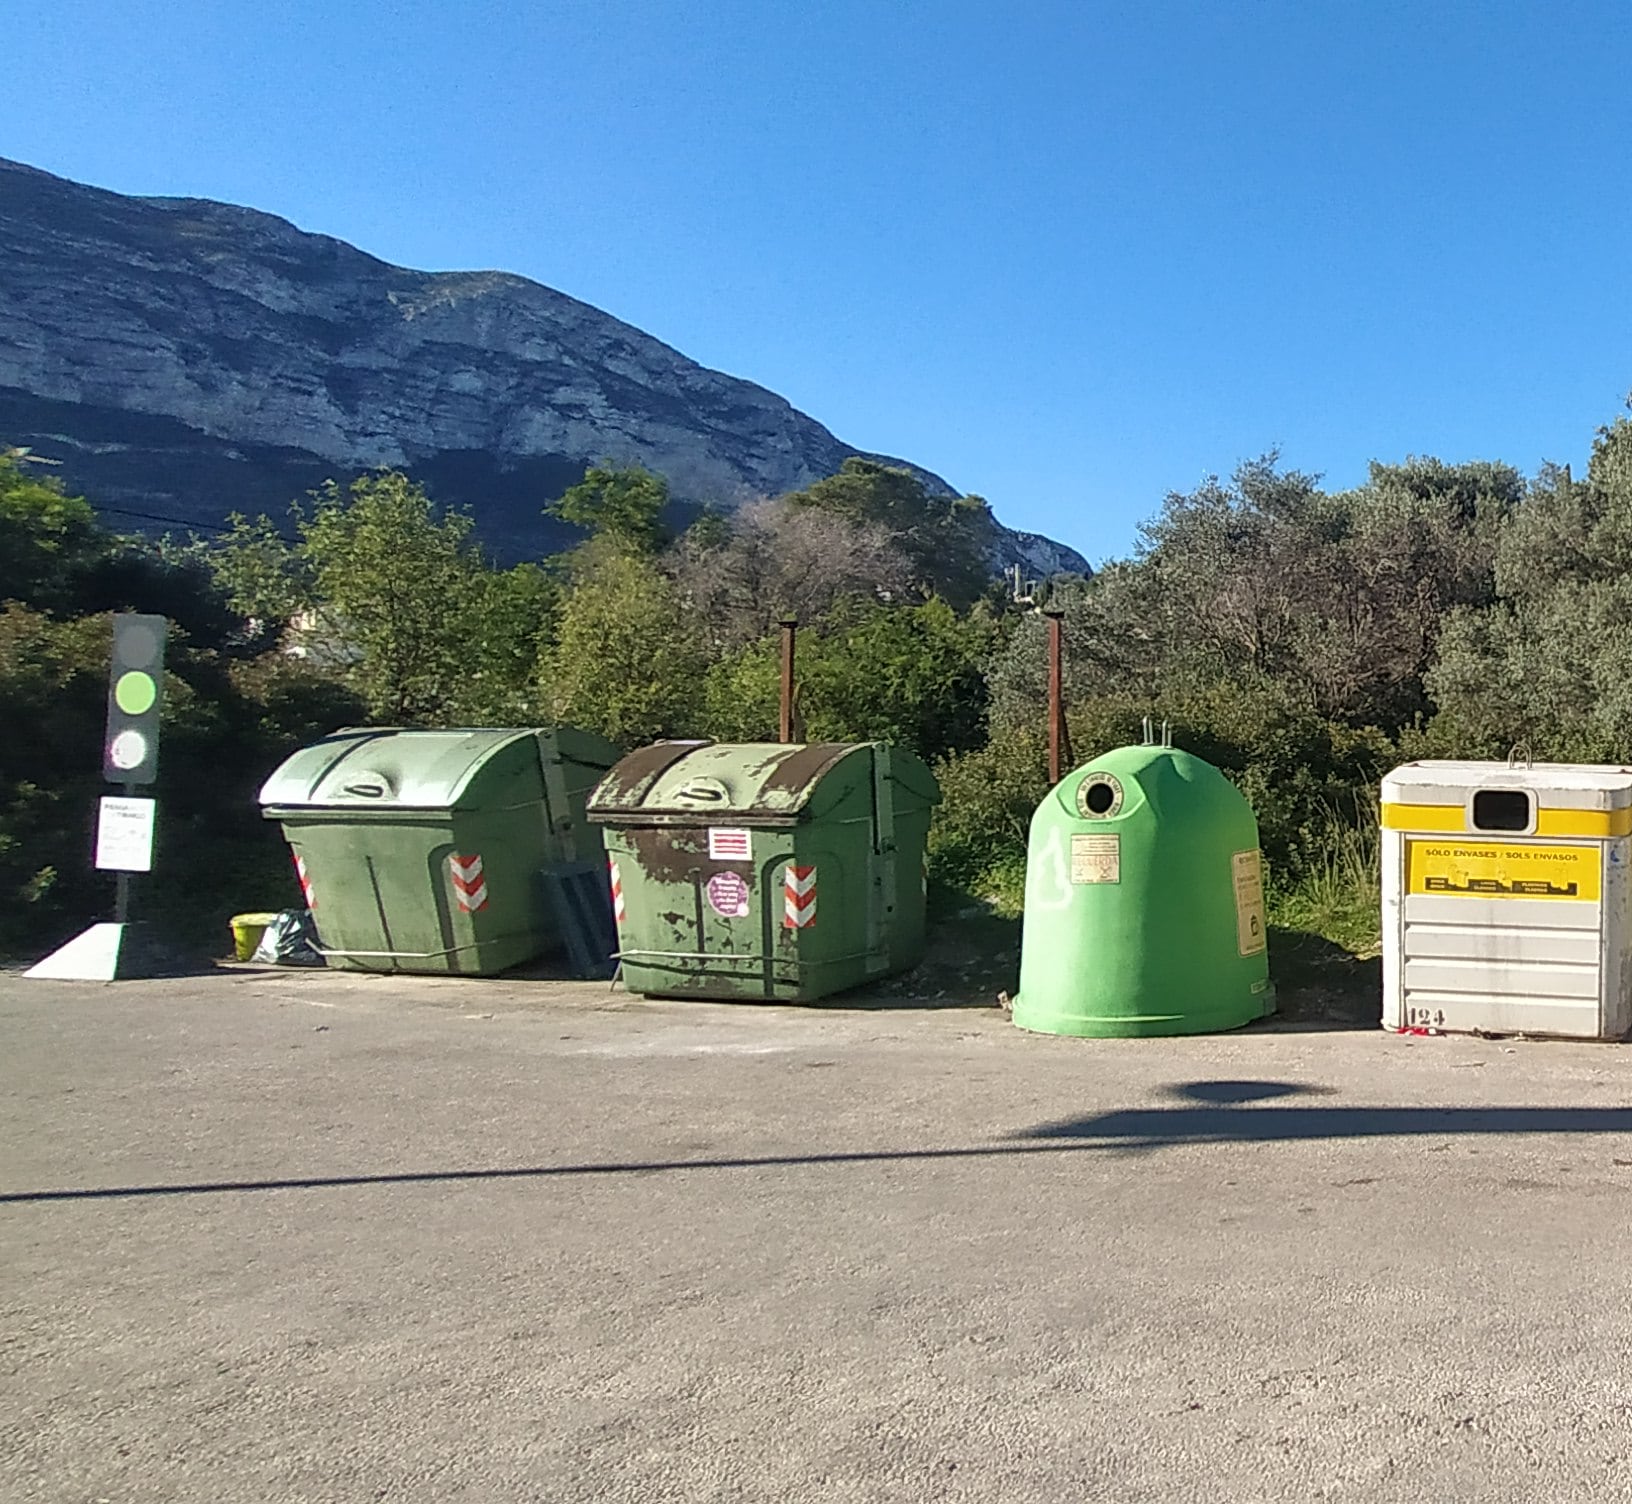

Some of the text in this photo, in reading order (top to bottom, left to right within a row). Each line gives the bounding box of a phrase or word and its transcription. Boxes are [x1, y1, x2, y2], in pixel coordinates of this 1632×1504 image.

[1453, 850, 1497, 858] ENVASES
[1505, 852, 1531, 860] SOLS
[1533, 853, 1578, 861] ENVASOS
[1411, 1007, 1445, 1026] 124
